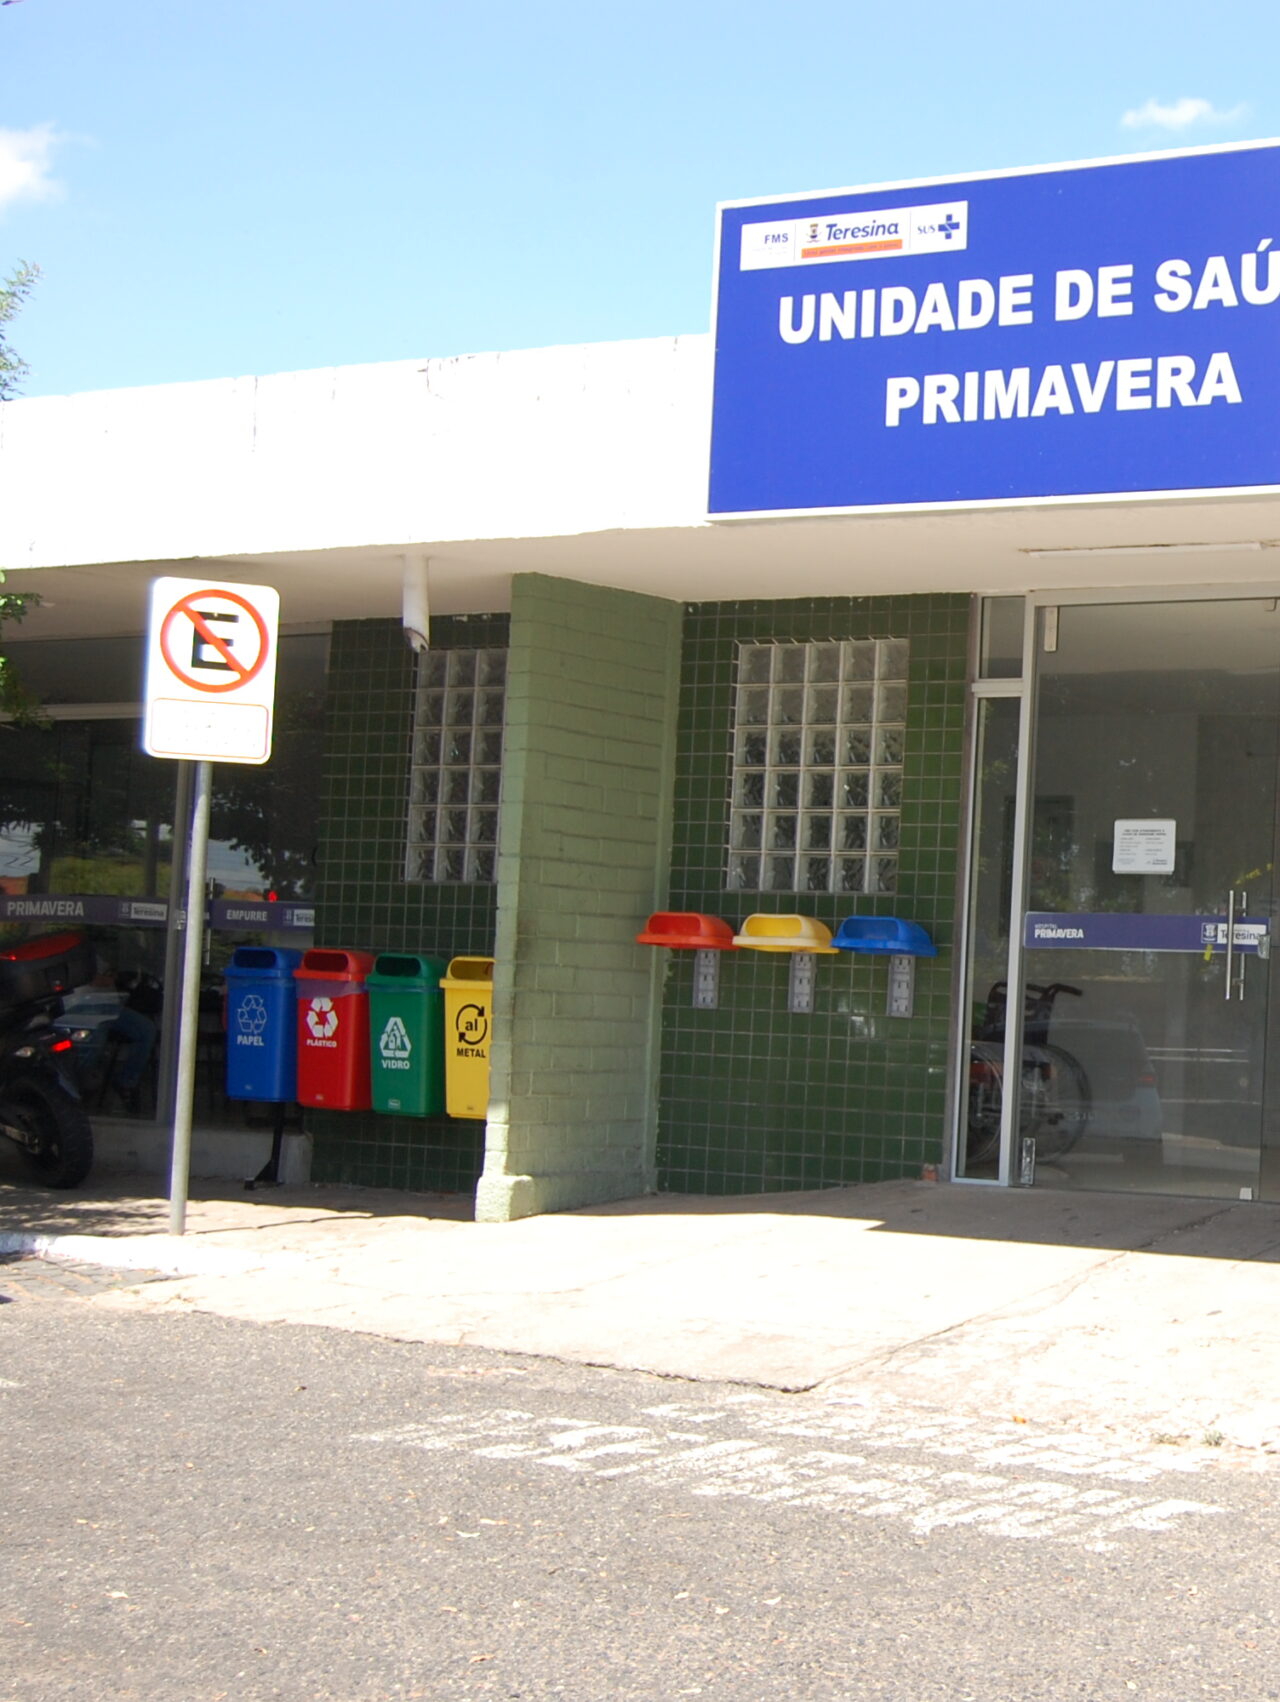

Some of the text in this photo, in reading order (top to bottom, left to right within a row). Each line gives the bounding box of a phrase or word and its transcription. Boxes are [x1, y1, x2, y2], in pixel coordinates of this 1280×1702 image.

[825, 219, 899, 241] Teresina
[917, 225, 936, 235] SUS
[764, 233, 789, 244] FMS
[779, 274, 1034, 344] UNIDADE
[1056, 264, 1134, 321] DE
[885, 352, 1243, 427] PRIMAVERA
[191, 611, 239, 671] E
[7, 900, 84, 916] PRIMAVERA
[226, 908, 268, 922] EMPURRE
[1034, 928, 1084, 939] PRIMAVERA
[1220, 930, 1263, 941] Teesina
[465, 1018, 478, 1032] al
[237, 1035, 264, 1047] PAPEL
[306, 1037, 337, 1048] PLÁSTICO
[456, 1048, 486, 1059] METAL
[381, 1059, 410, 1070] VIDRO
